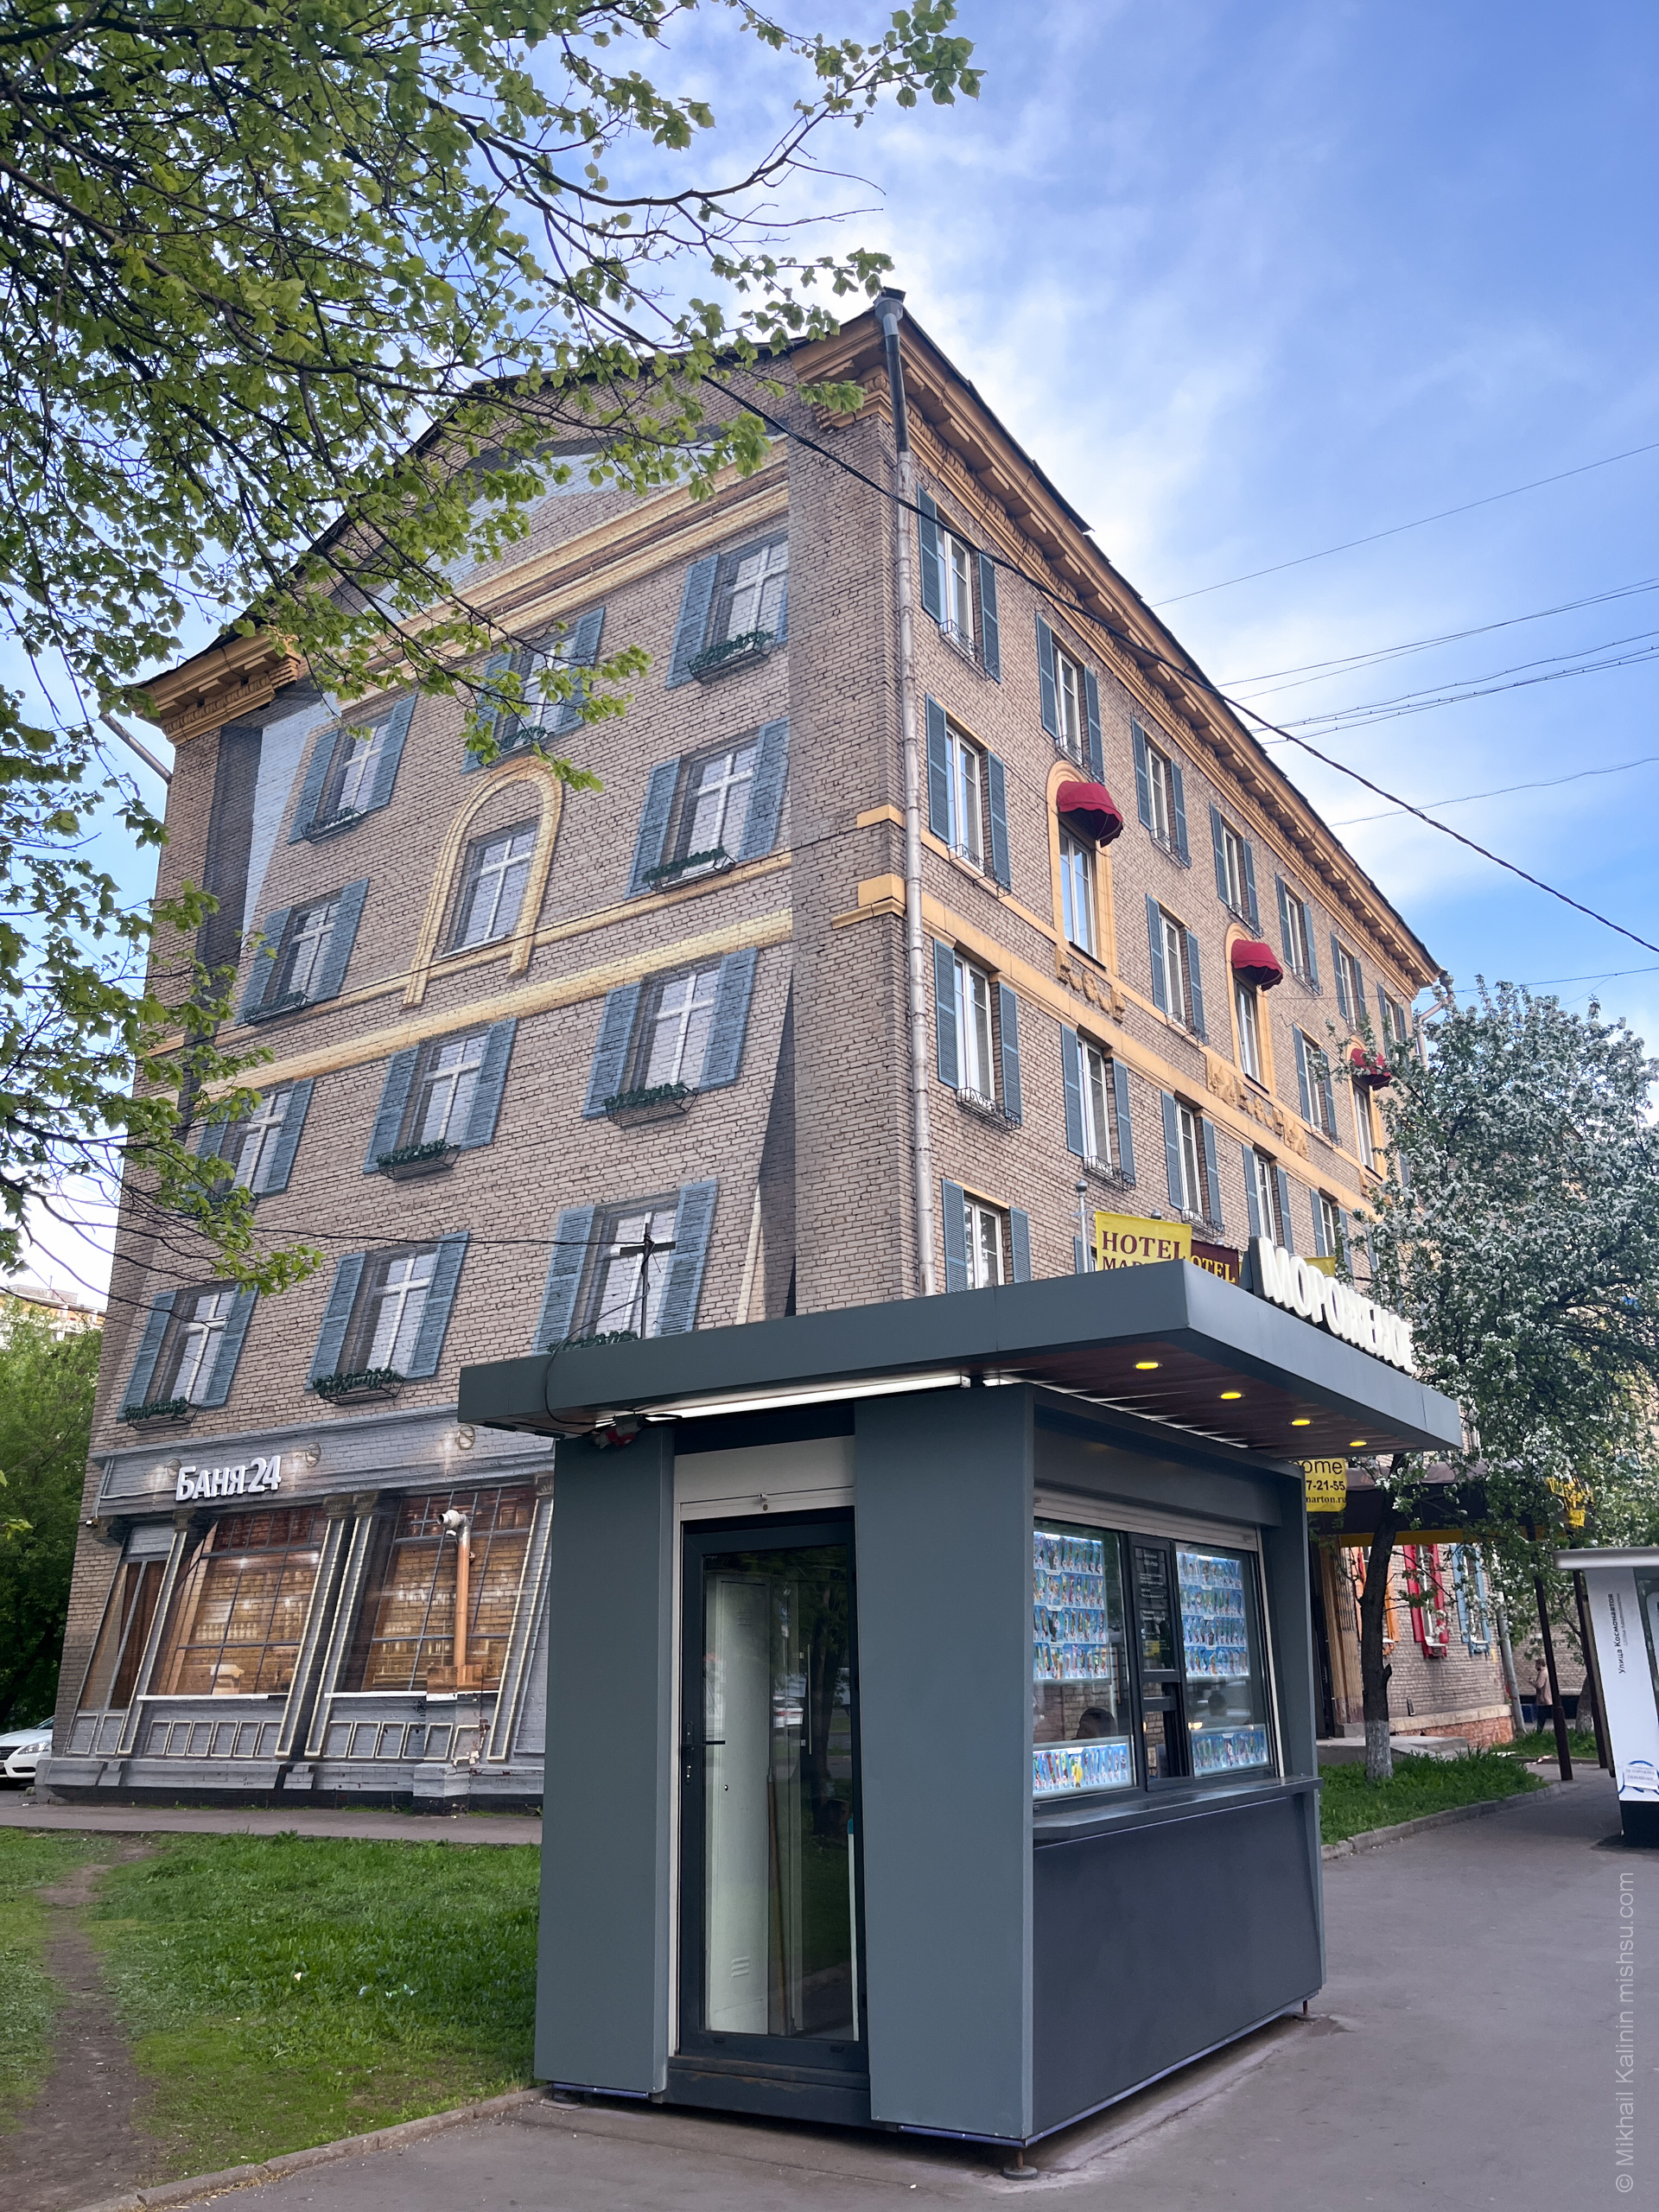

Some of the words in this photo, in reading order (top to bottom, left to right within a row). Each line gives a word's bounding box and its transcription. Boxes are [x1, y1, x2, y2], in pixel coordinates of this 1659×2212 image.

[1102, 1230, 1185, 1260] HOTEL
[1259, 1236, 1417, 1374] МОРОЖЕНОЕ
[1294, 1460, 1343, 1474] ome
[1608, 1593, 1621, 1647] Космонавтов
[1618, 1649, 1626, 1674] Улица
